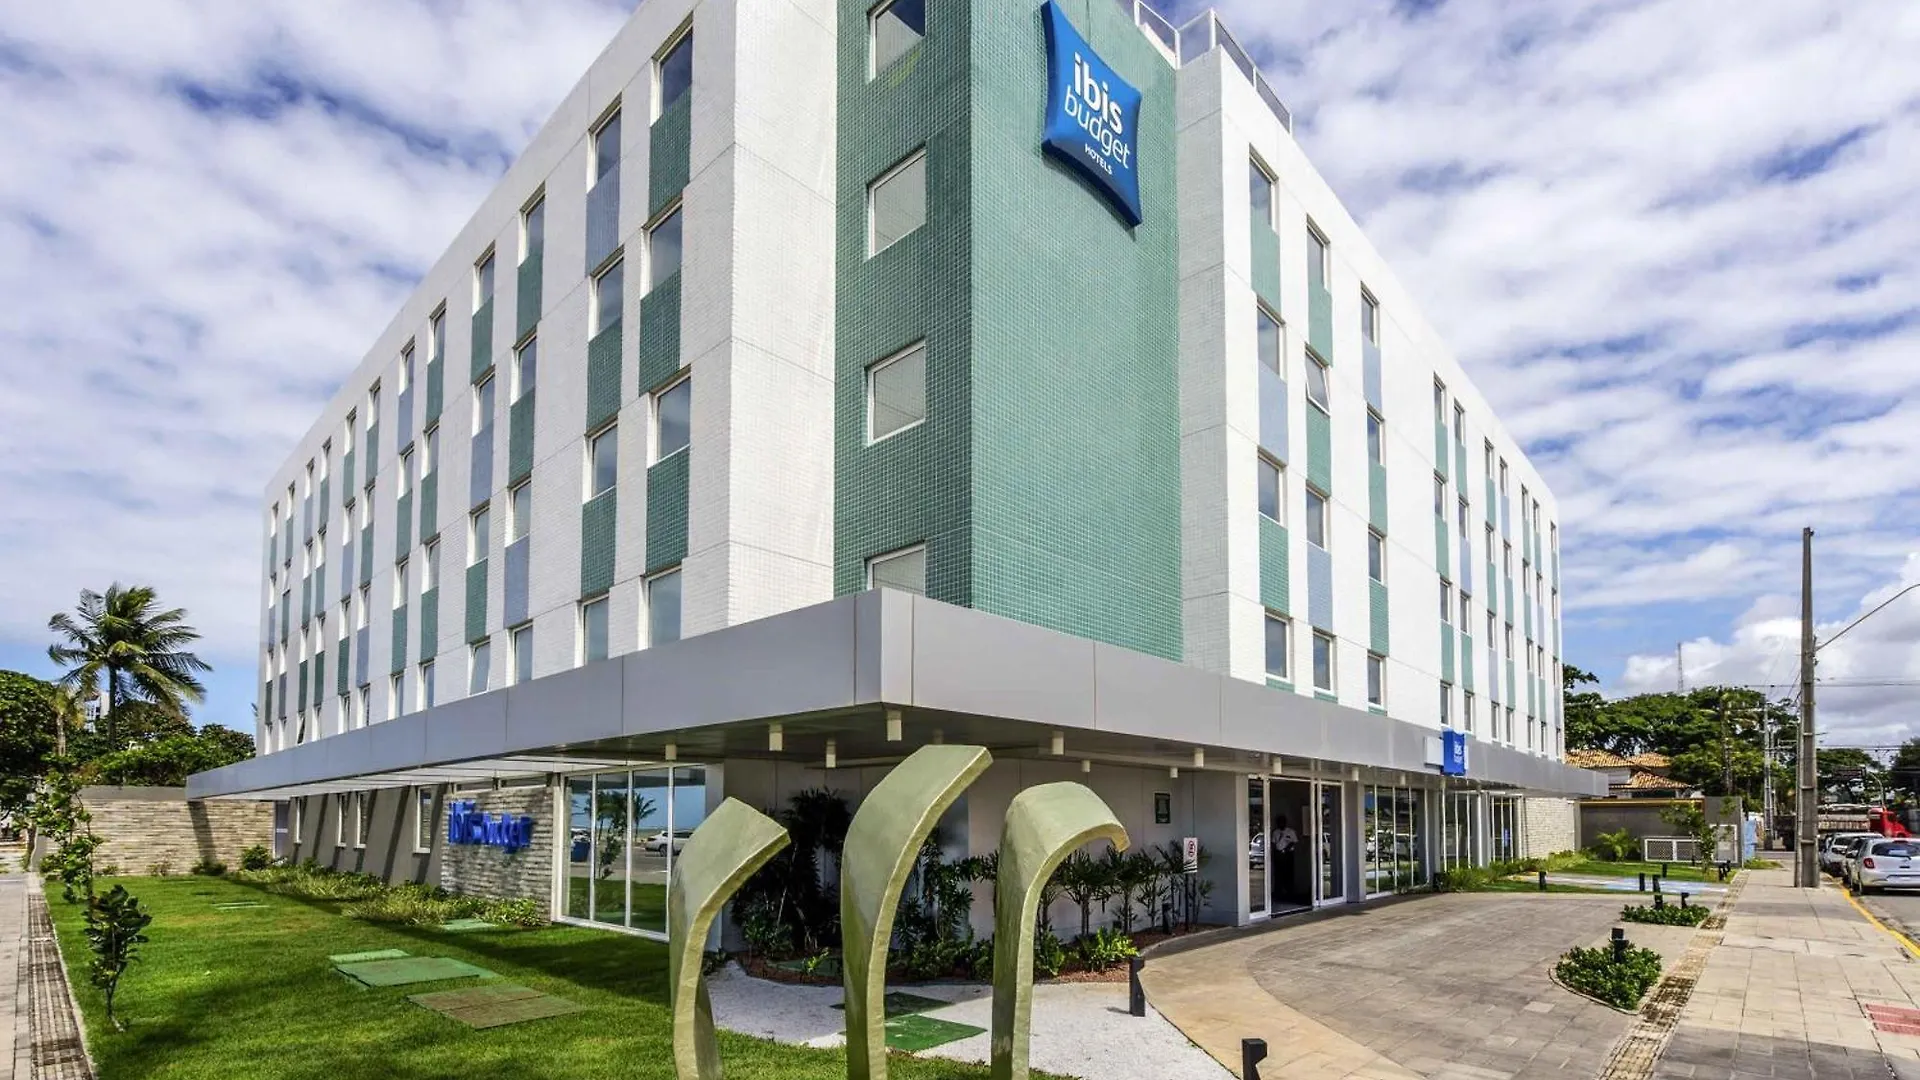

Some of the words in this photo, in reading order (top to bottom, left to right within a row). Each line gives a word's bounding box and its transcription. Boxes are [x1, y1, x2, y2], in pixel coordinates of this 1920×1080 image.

[1065, 85, 1131, 168] budget
[1074, 52, 1123, 134] ibis
[1085, 143, 1113, 175] HOTELS
